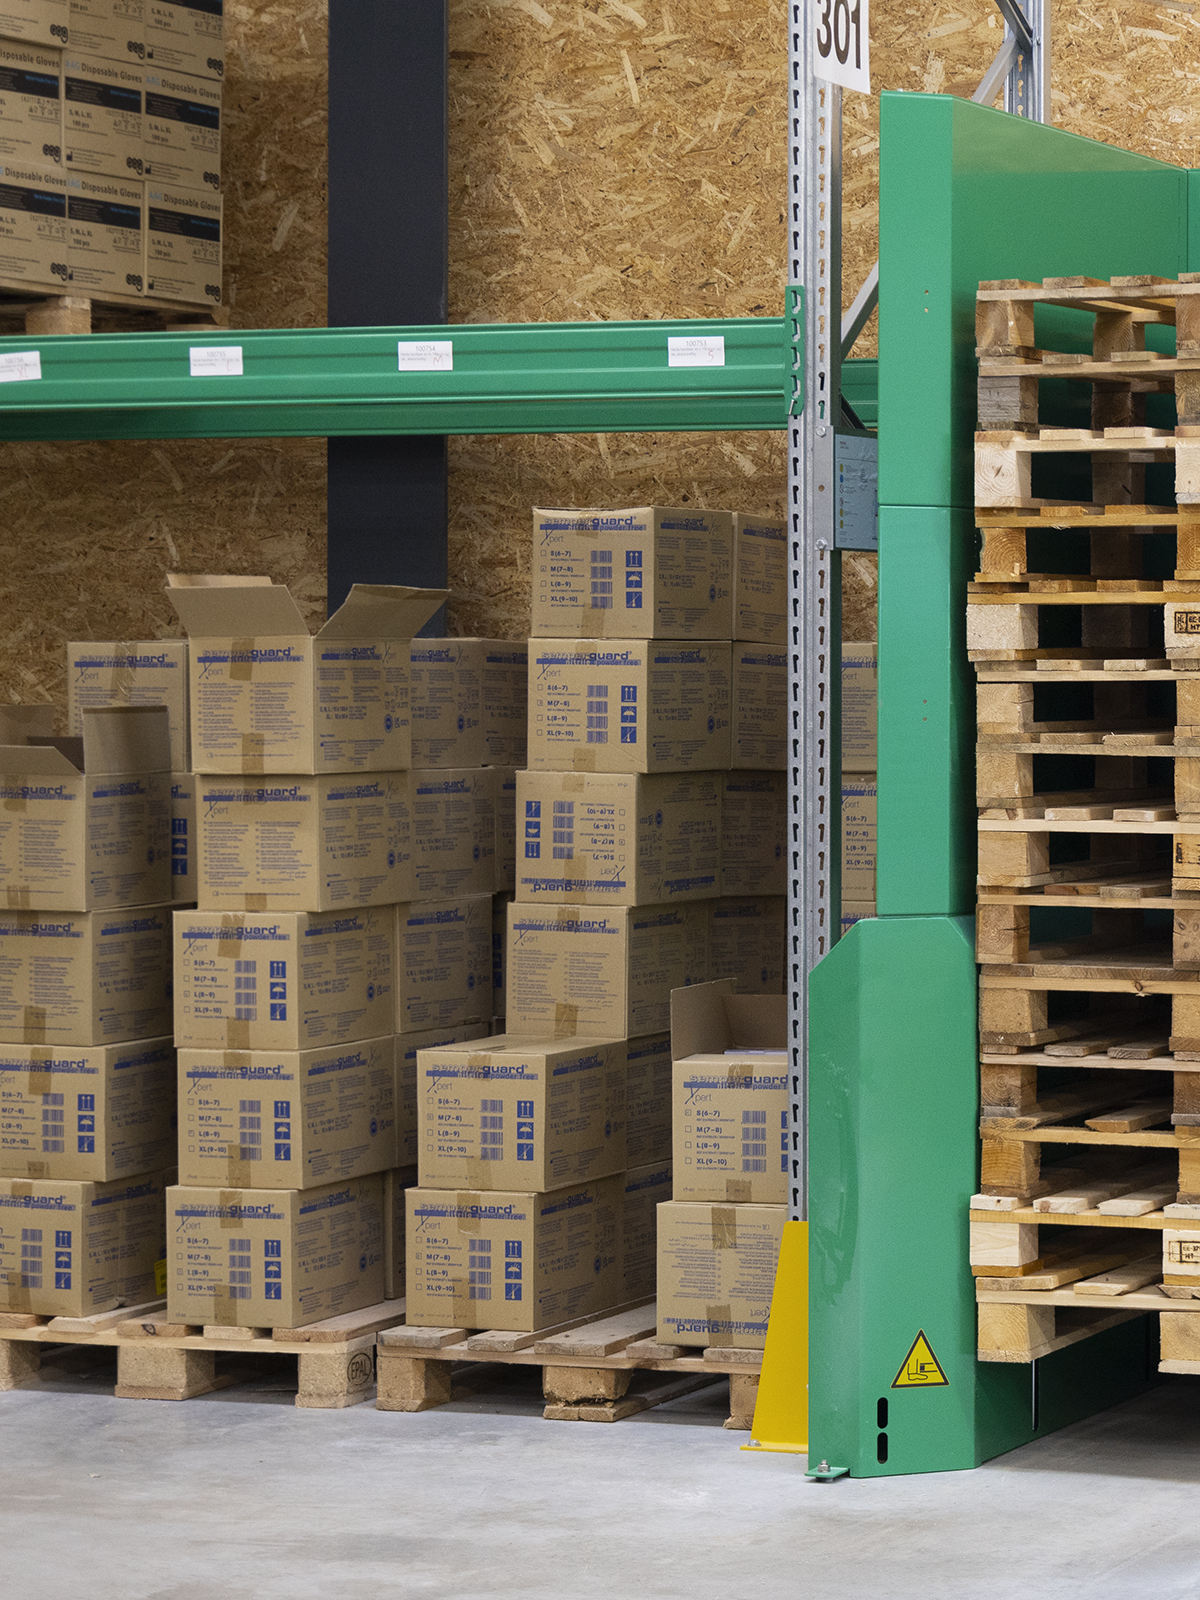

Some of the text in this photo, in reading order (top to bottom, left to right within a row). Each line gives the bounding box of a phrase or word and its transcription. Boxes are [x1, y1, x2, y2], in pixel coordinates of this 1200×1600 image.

[817, 0, 861, 70] 301
[36, 56, 59, 68] Gloves
[81, 63, 118, 78] Disposable
[120, 70, 142, 84] Gloves
[161, 79, 197, 95] Disposable
[199, 88, 220, 100] Gloves
[5, 167, 67, 186] Disposable Gloves
[81, 181, 118, 196] Disposable
[120, 188, 142, 200] Gloves
[164, 194, 199, 208] Disposable
[200, 200, 220, 212] Gloves
[351, 1360, 369, 1379] EPAL
